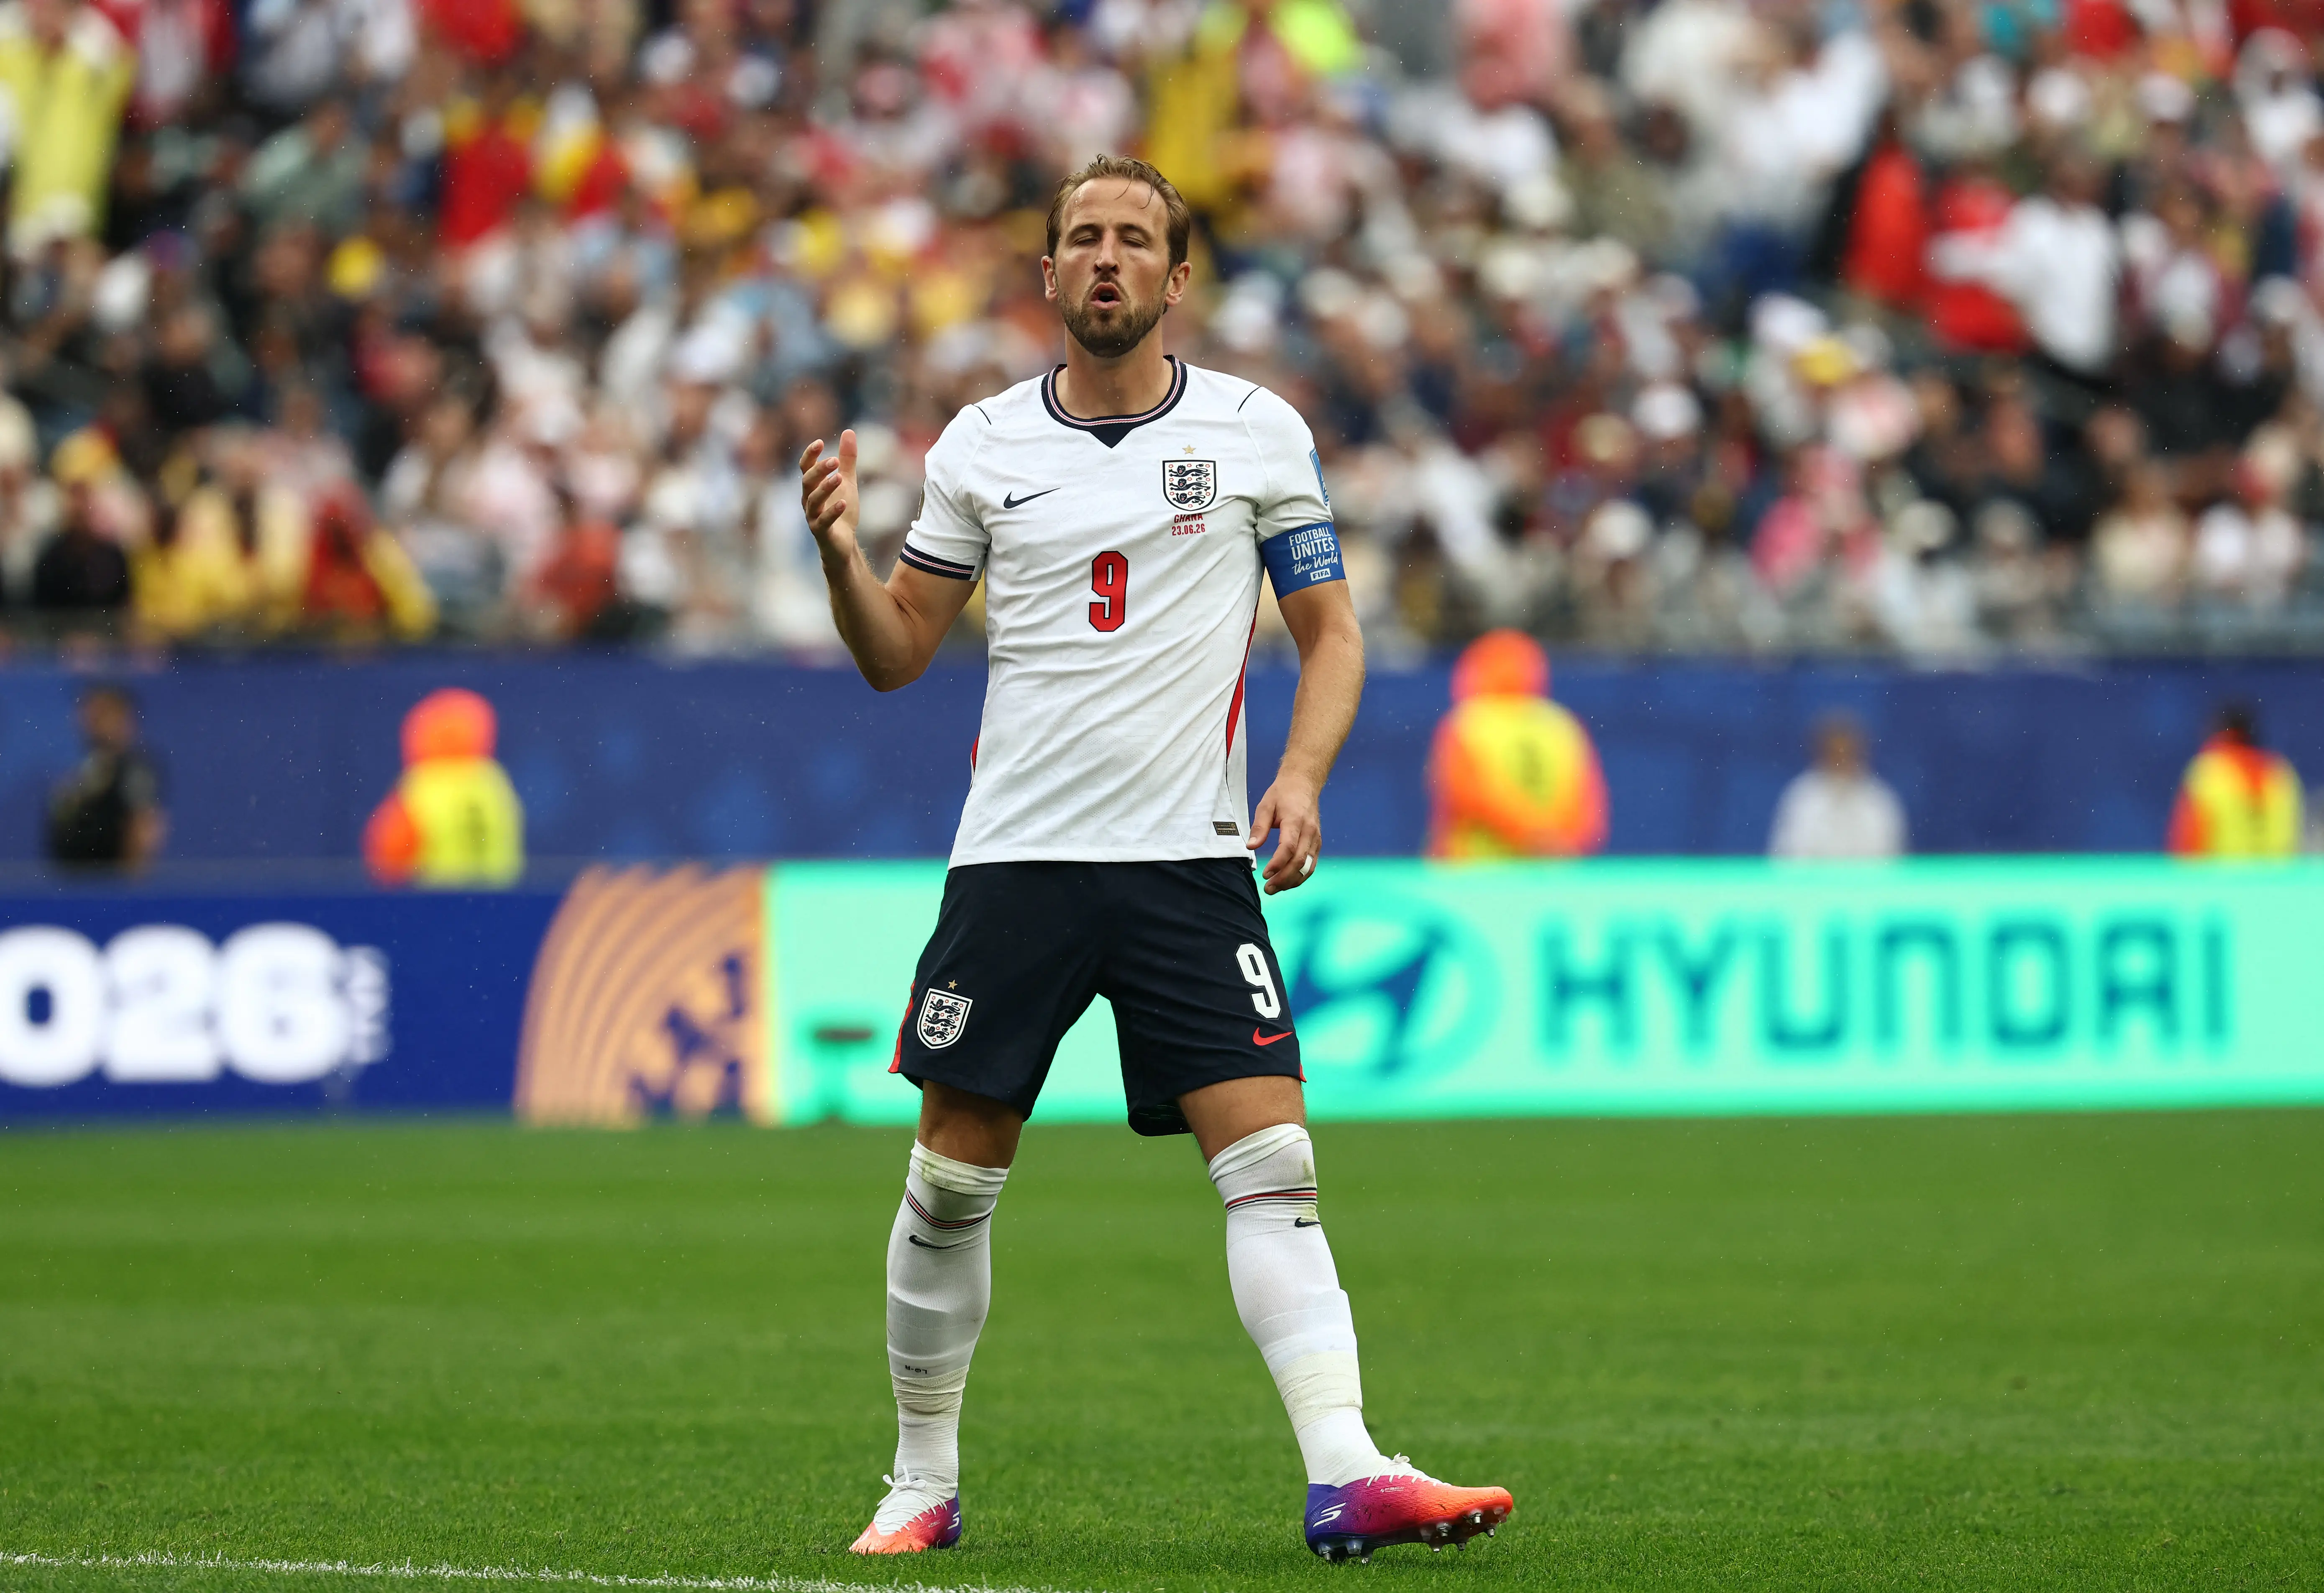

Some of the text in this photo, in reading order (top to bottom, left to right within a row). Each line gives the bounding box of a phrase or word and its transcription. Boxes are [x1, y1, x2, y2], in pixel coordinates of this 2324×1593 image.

[1172, 523, 1206, 536] 23.06.26
[1174, 513, 1203, 523] GHANA
[1289, 526, 1331, 546] FOOTBALL
[1291, 537, 1335, 560] UNITES
[1291, 551, 1338, 575] the World
[1312, 571, 1329, 579] FIFA
[1089, 551, 1128, 632] 9
[1234, 942, 1282, 1020] 9
[1539, 910, 2234, 1058] HYUNDAI
[0, 922, 341, 1084] 026
